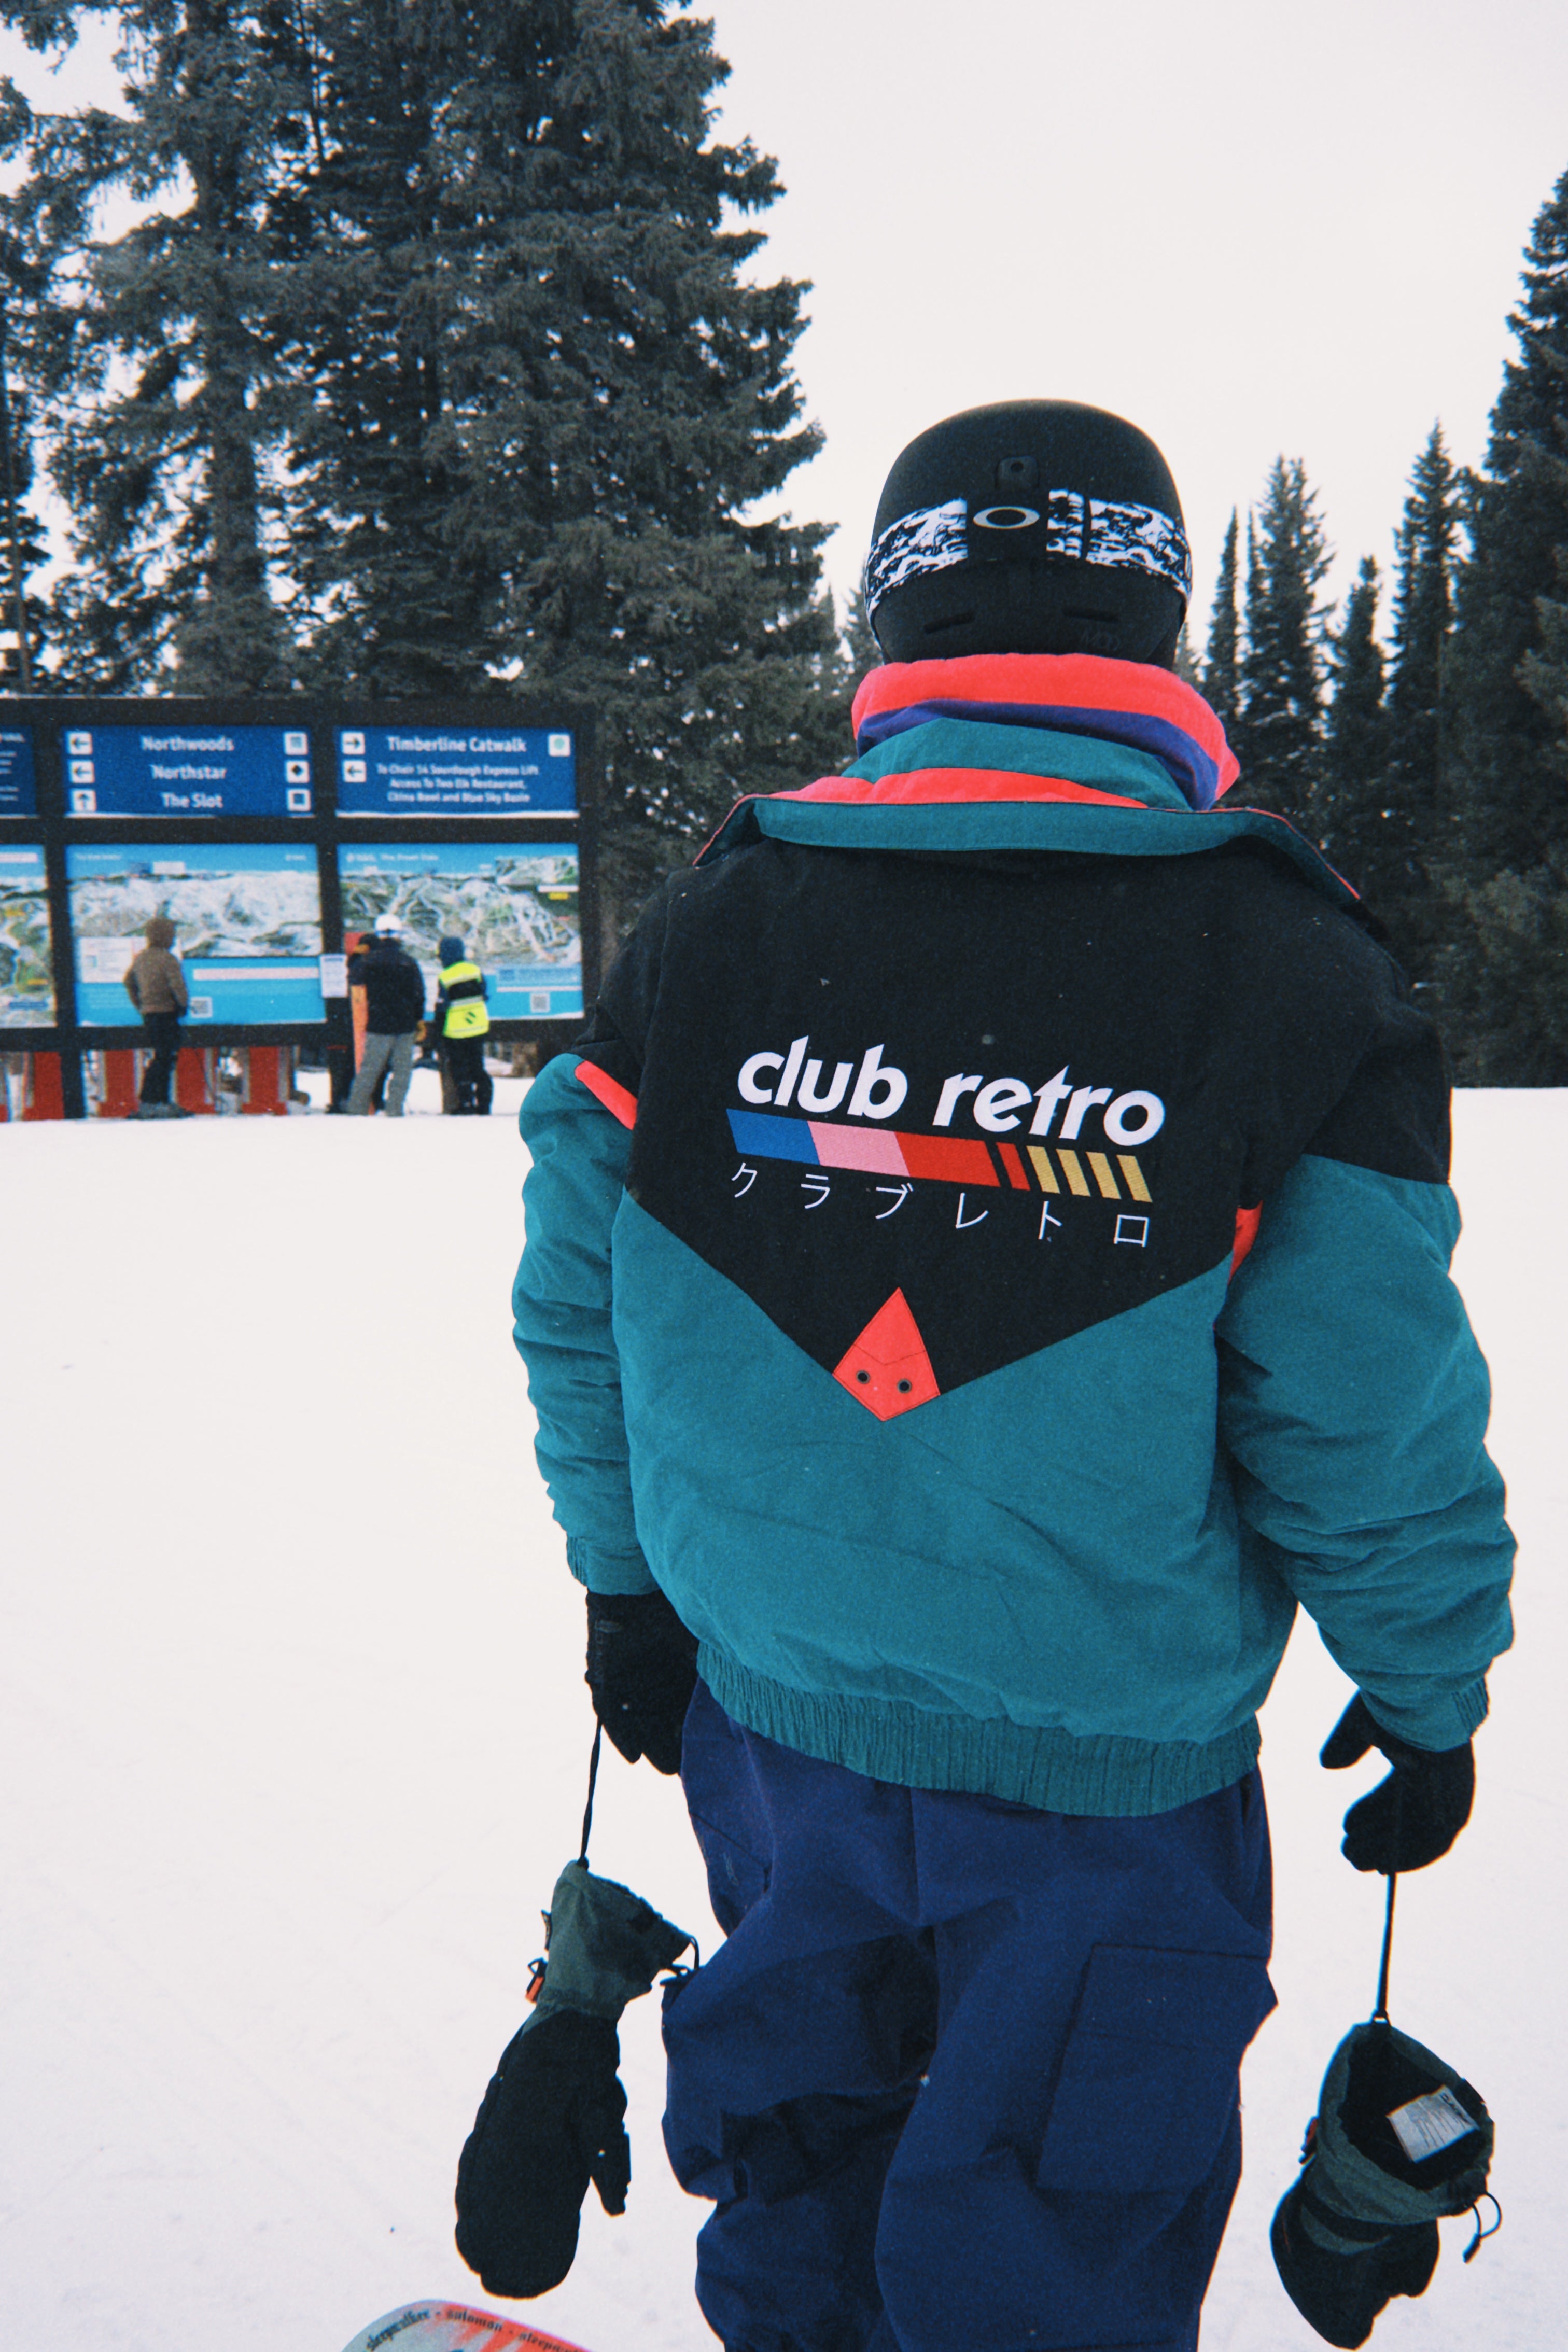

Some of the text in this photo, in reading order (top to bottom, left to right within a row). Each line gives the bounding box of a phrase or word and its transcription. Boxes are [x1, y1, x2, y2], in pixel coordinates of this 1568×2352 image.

[141, 735, 234, 751] Northwoods
[387, 735, 526, 752] Timberline Catwalk
[149, 763, 227, 780] Northstar
[483, 765, 519, 777] Express
[520, 764, 539, 775] Lift
[161, 792, 223, 808] The Slot
[442, 792, 460, 802] and
[461, 792, 484, 803] Blue
[485, 792, 501, 804] Sky
[737, 1035, 1166, 1146] club retro
[731, 1161, 1150, 1248] クラブレトロ
[446, 2309, 503, 2333] salomon
